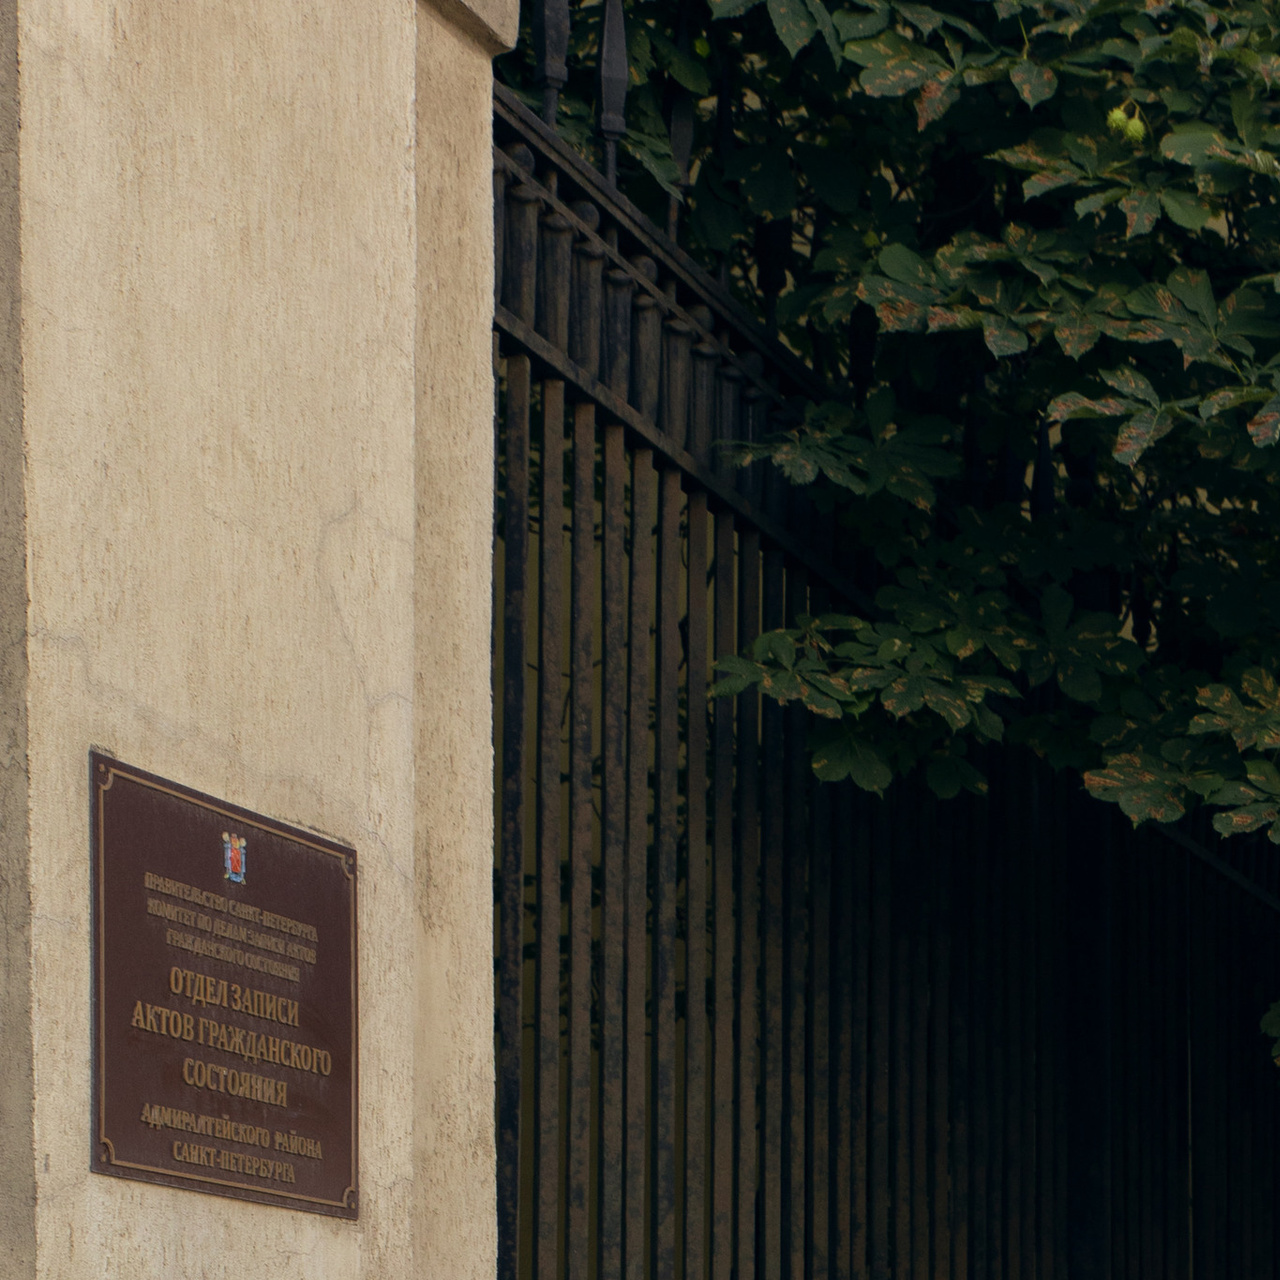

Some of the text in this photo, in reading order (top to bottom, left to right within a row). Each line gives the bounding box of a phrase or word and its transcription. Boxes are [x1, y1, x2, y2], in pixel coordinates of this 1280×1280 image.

[144, 872, 319, 943] ПРАВИТЕЛЬСТВО САНКТ-ПЕТЕРБУРГА
[147, 897, 317, 965] КОМИТЕТ ПО ДЕЛАМ ЗАПИСИ АКТОВ
[166, 928, 301, 982] ГРАЖДАНСКОГО СОСТОЯНИЯ
[170, 966, 299, 1027] ОТДЕЛ ЗАПИСИ
[131, 1000, 332, 1076] АКТОВ ГРАЖДАНСКОГО
[182, 1058, 288, 1108] СОСТОЯНИЯ
[140, 1102, 323, 1160] АДМИРАЛТЕЙСКОГО РАЙОНА
[172, 1140, 296, 1184] САНКТ-ПЕТЕРБУРГА
